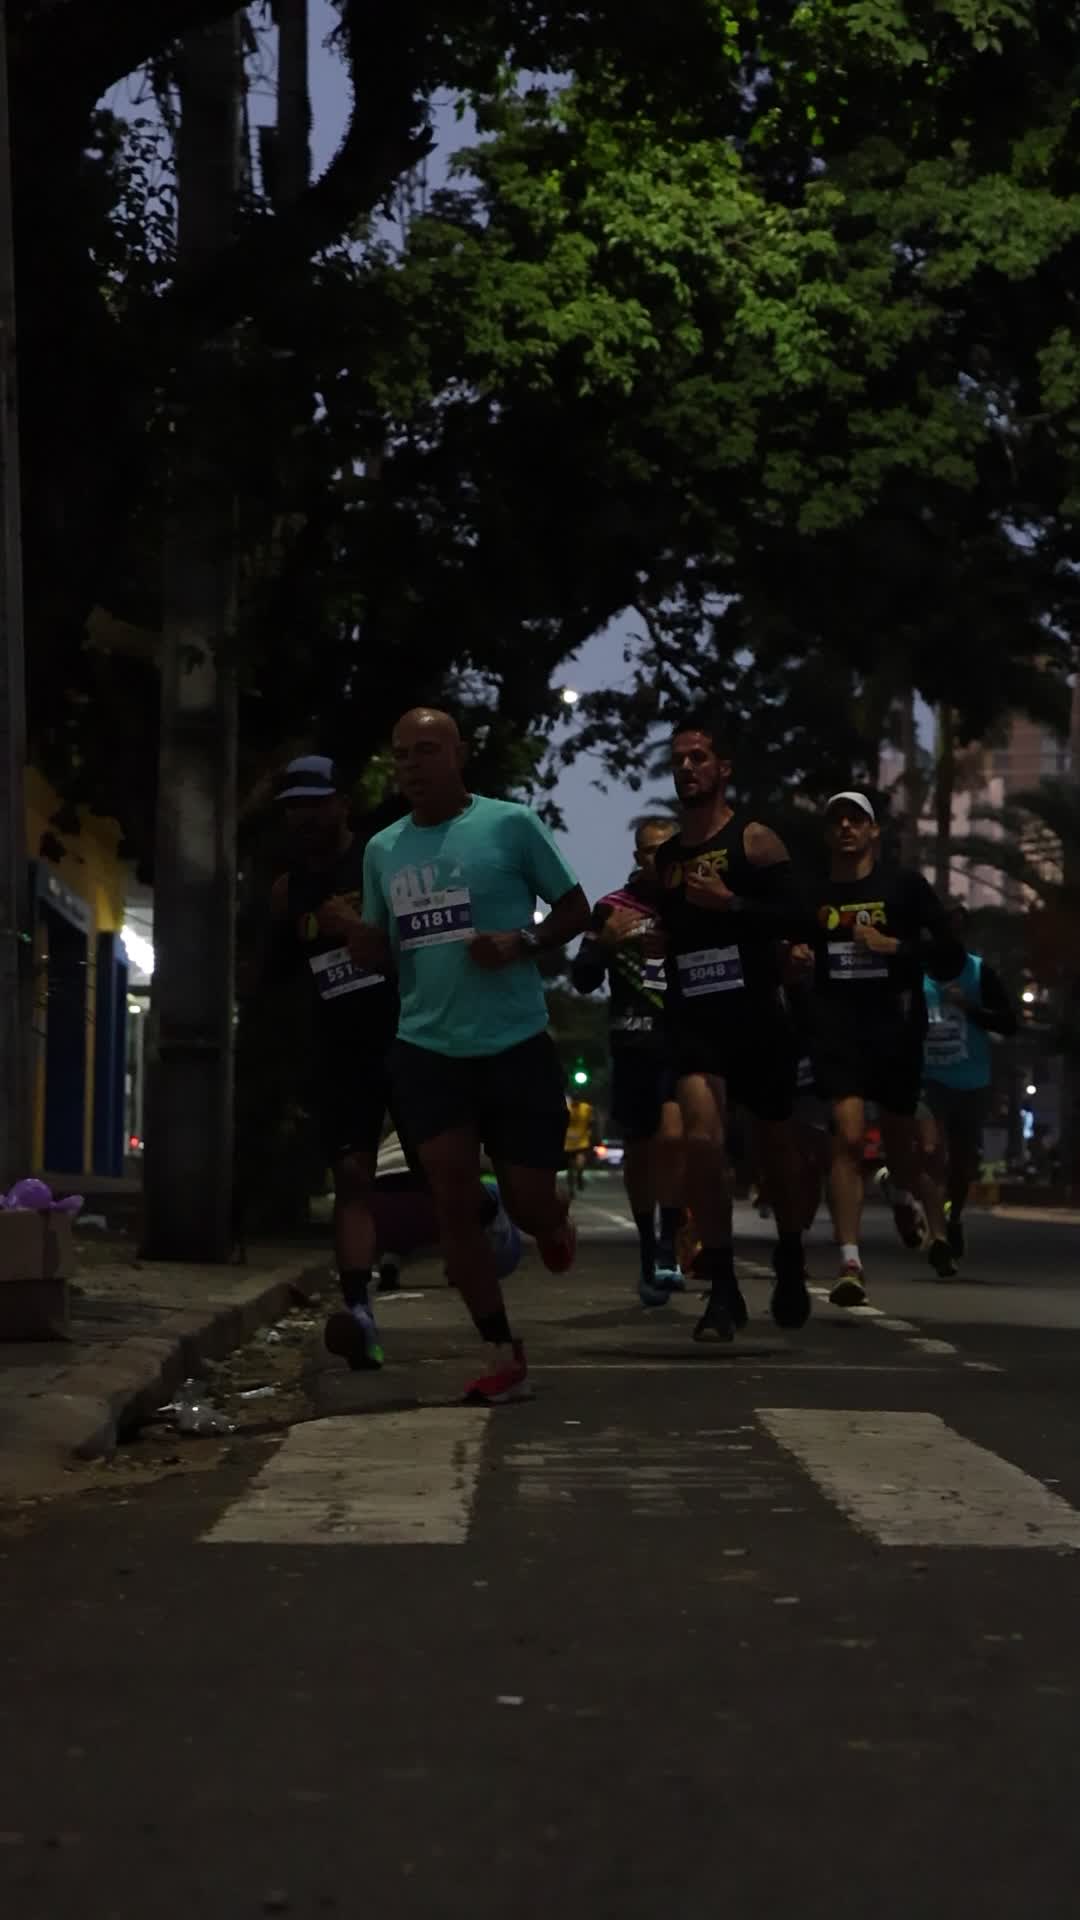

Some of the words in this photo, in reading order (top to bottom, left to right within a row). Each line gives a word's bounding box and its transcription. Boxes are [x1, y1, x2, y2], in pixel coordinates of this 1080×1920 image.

[411, 908, 453, 930] 6181
[327, 962, 364, 983] 551
[689, 962, 726, 982] 5048
